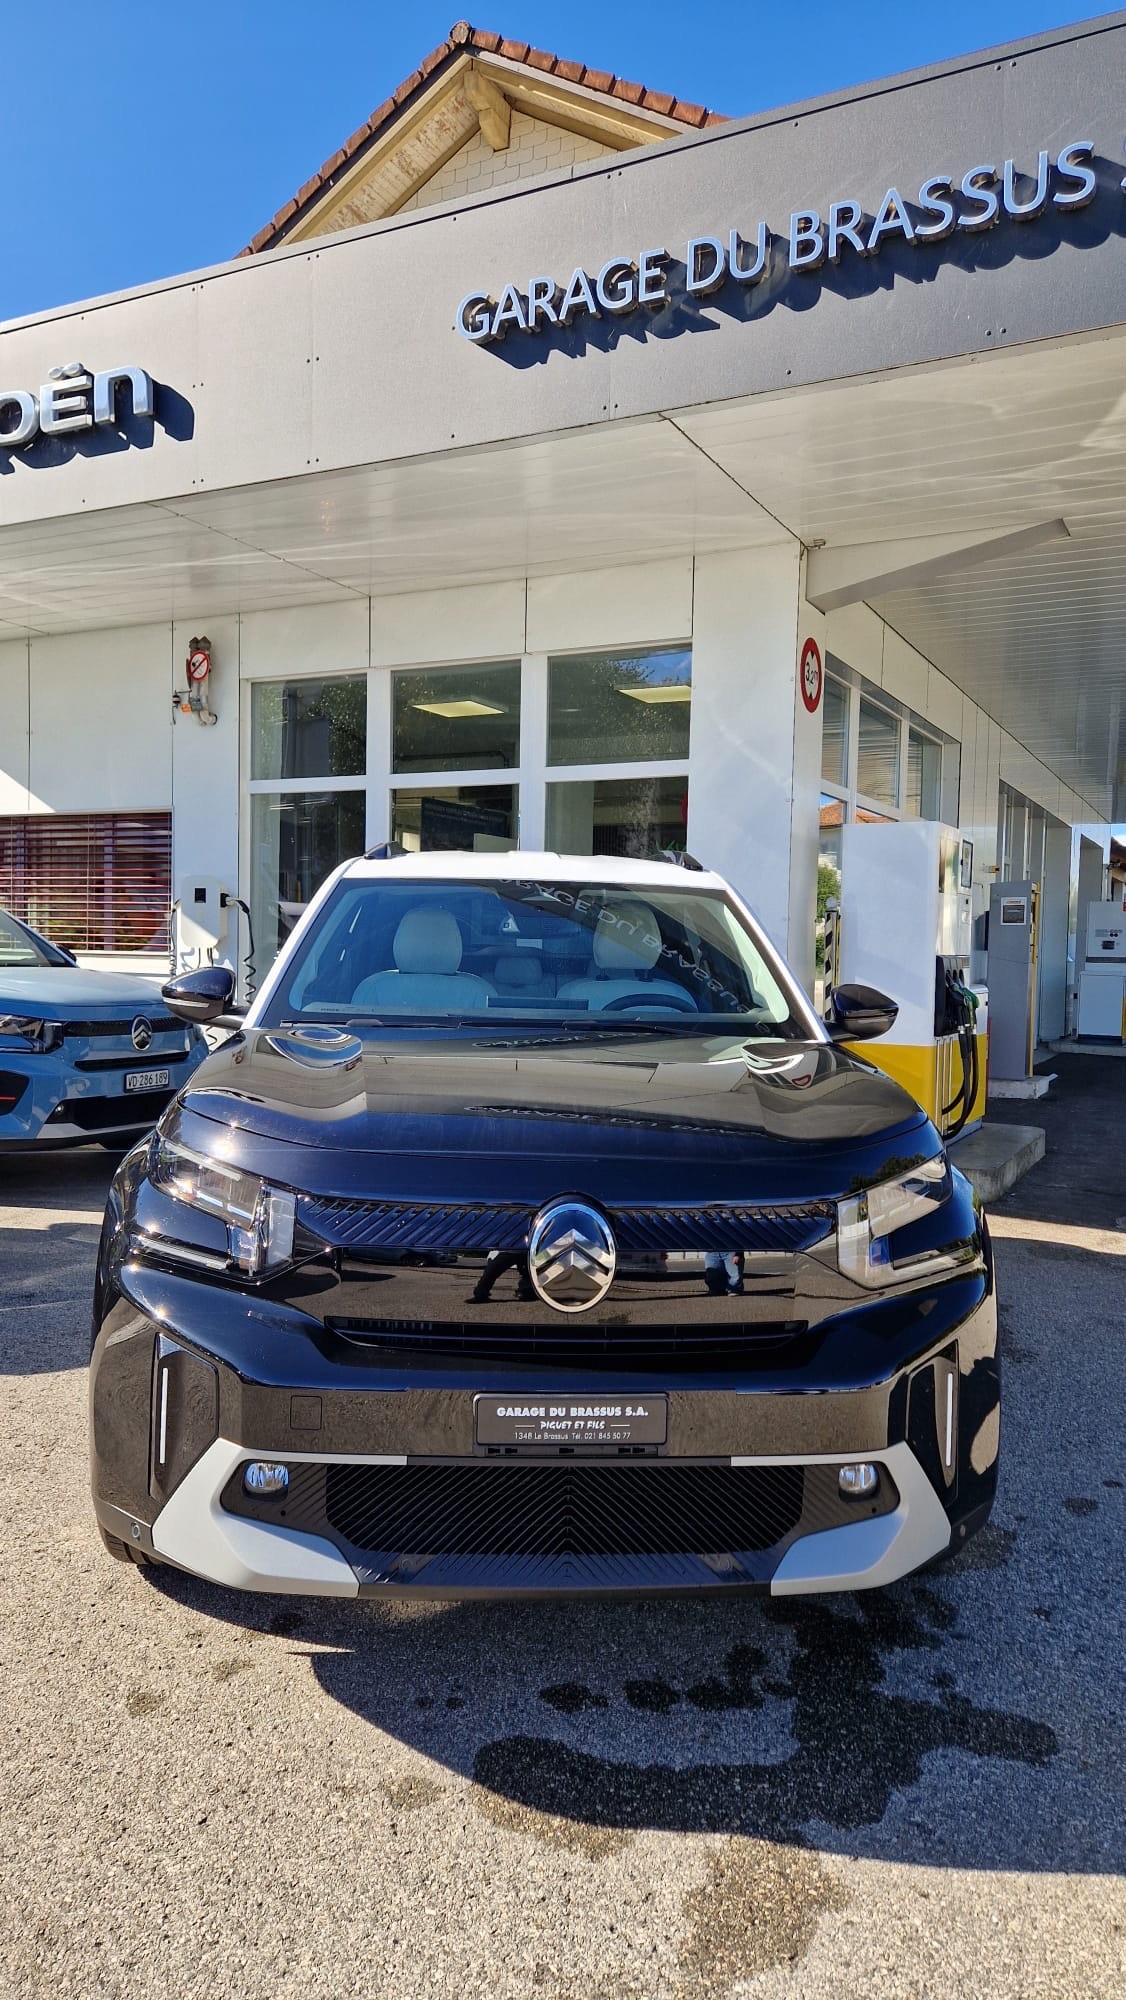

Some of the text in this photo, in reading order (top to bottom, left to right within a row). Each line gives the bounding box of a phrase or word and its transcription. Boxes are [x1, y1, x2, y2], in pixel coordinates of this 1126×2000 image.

[455, 247, 667, 342] GARAGE
[686, 220, 768, 294] DU
[789, 140, 1096, 268] BRASSUS
[497, 1406, 649, 1417] GARAGE DU BRASSUS S.A.
[540, 1420, 606, 1430] PIGUET ET FILS
[514, 1432, 533, 1440] 1348
[534, 1432, 542, 1440] Le
[543, 1432, 569, 1440] Brassus
[584, 1432, 596, 1440] 021
[598, 1432, 611, 1440] 845
[612, 1432, 621, 1440] 50
[622, 1432, 631, 1440] 77
